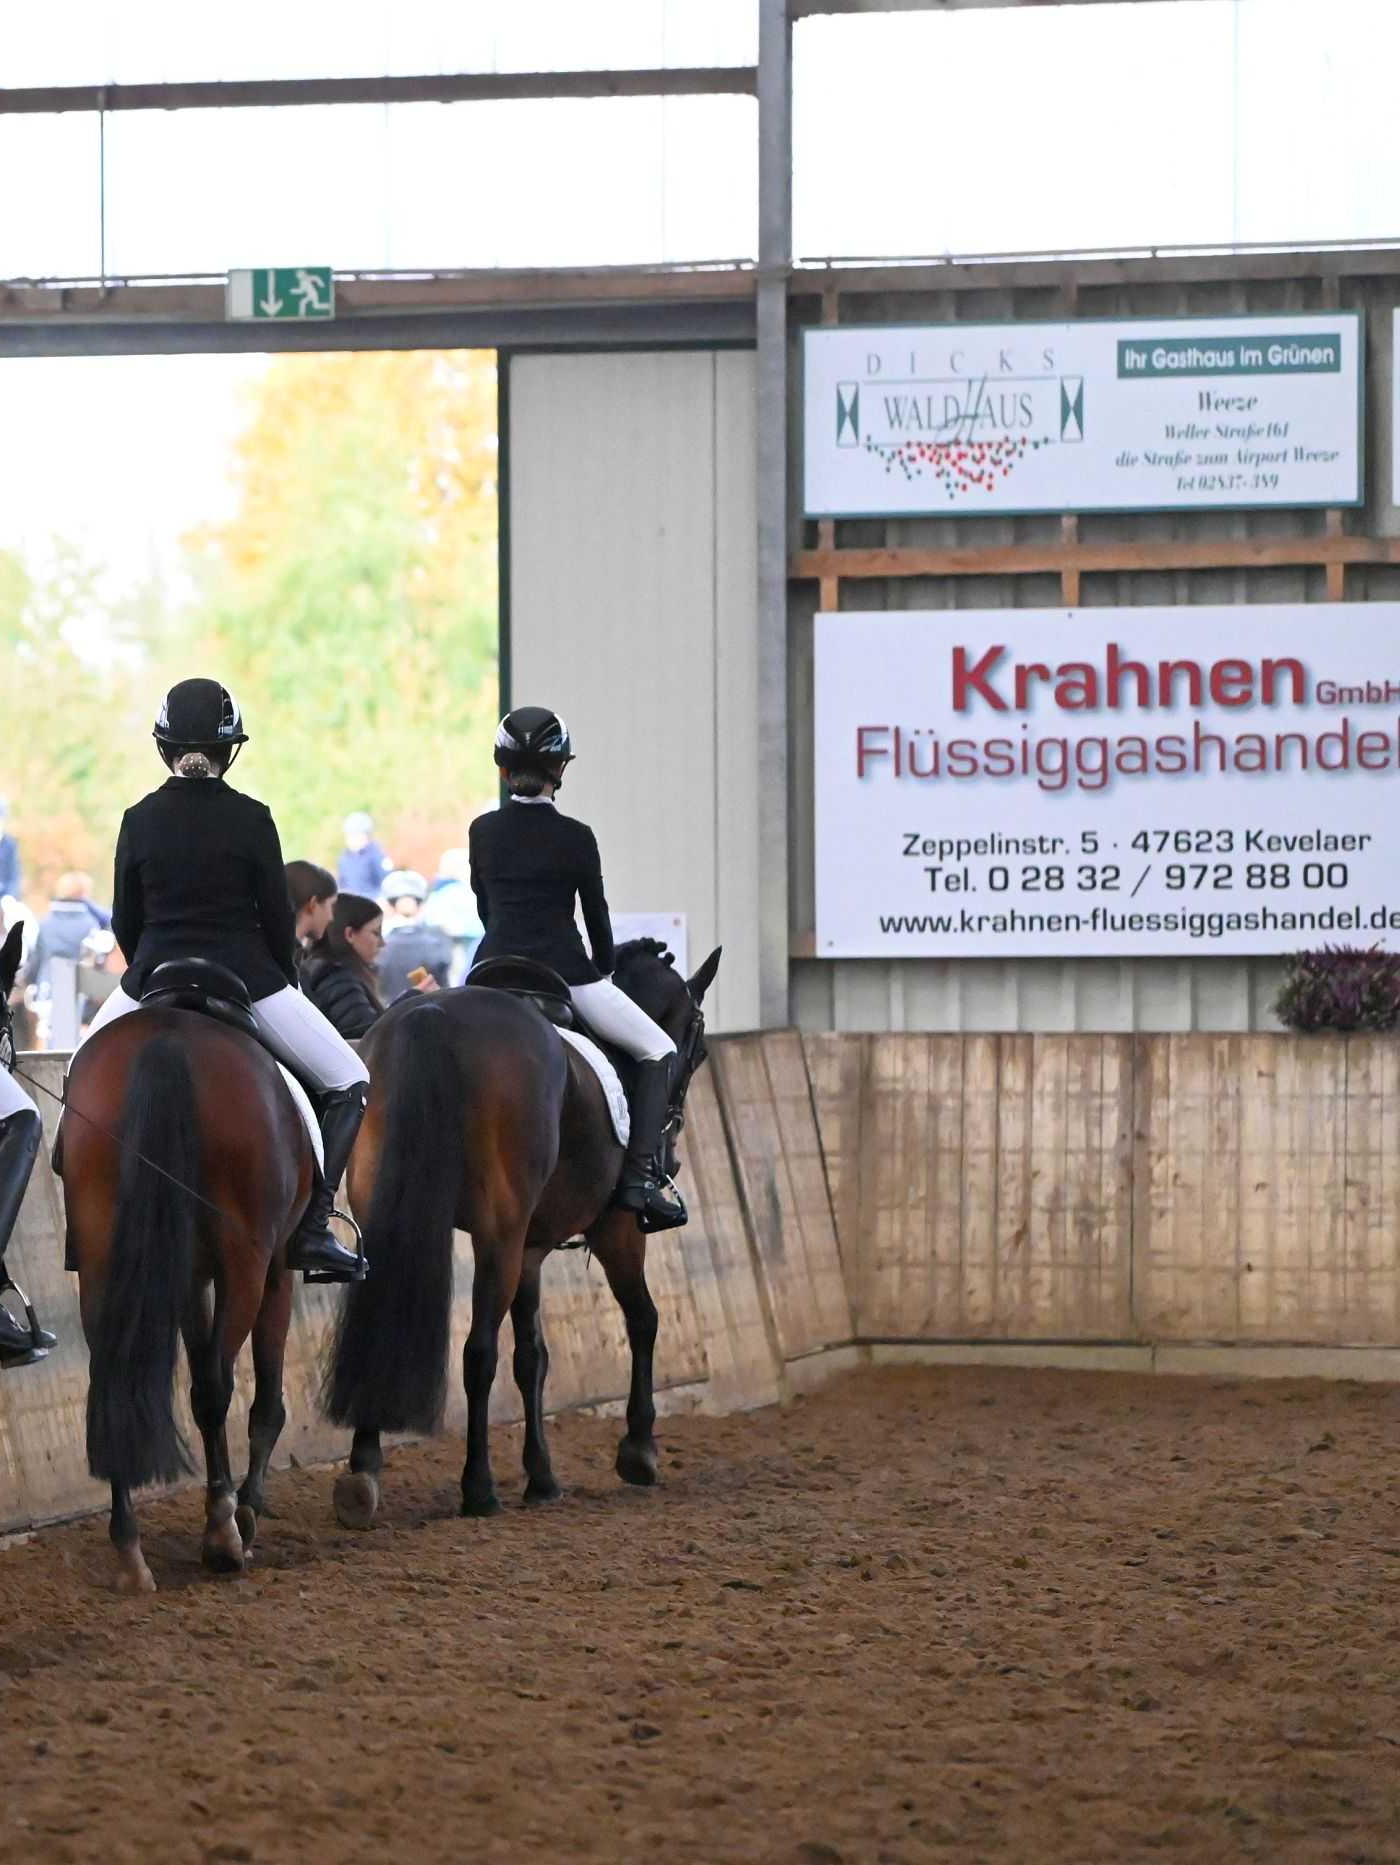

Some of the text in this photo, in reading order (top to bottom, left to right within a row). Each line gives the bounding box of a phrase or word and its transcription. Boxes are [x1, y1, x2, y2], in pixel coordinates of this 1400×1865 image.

[866, 349, 1055, 375] DICKS
[1125, 348, 1146, 369] Ihr
[1152, 347, 1235, 369] Gasthaus
[1268, 343, 1335, 366] Grünen
[884, 376, 1034, 442] WALDHAUS
[1198, 391, 1258, 412] Weeze
[1115, 451, 1139, 468] die
[1294, 446, 1340, 464] Weeze
[952, 643, 1400, 711] Krahnen GmbH
[903, 833, 1070, 861] Zeppelinstr.
[1081, 831, 1099, 854] 5
[1131, 830, 1234, 853] 47623
[1245, 829, 1372, 851] Kevelaer
[924, 866, 977, 892] Tel.
[1021, 865, 1065, 891] 28
[1077, 865, 1121, 891] 32
[1165, 864, 1233, 890] 972
[1246, 863, 1290, 889] 88
[1303, 863, 1349, 888] 00
[879, 905, 1400, 937] www.krahnen-fluessiggashandel.de
